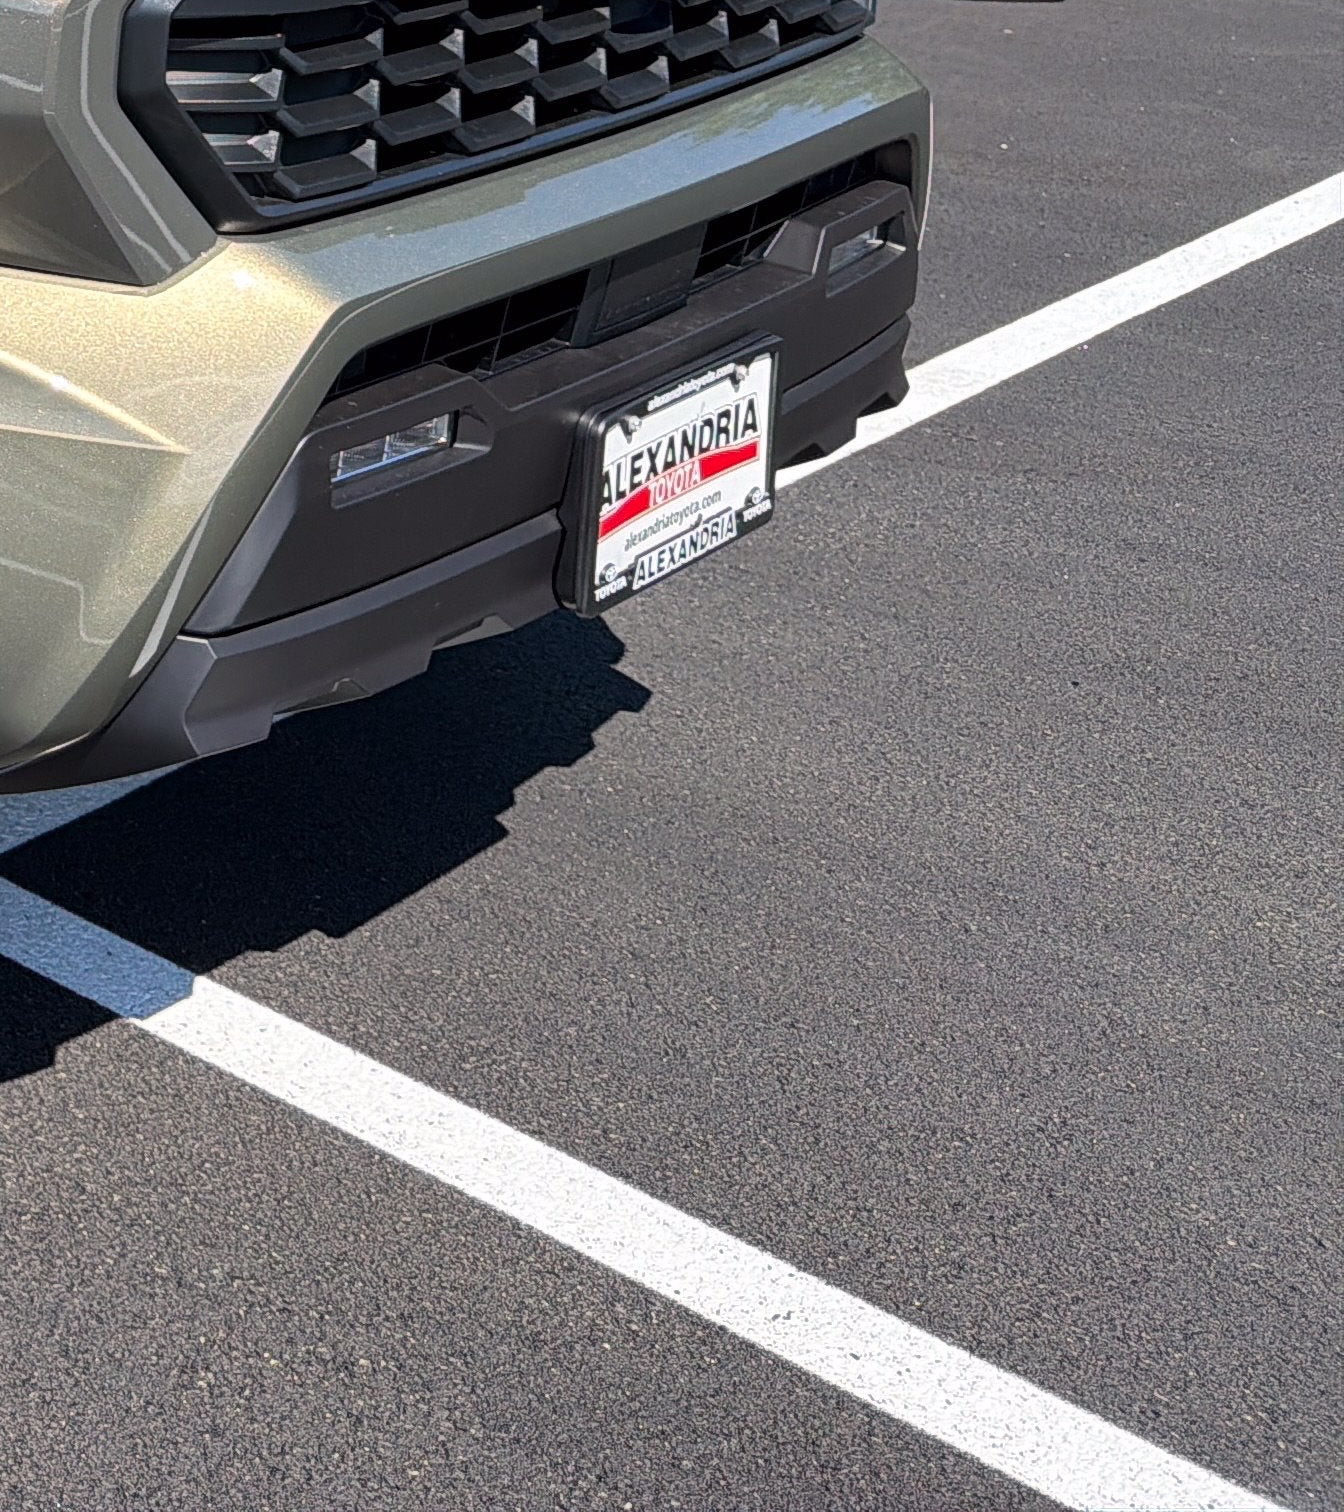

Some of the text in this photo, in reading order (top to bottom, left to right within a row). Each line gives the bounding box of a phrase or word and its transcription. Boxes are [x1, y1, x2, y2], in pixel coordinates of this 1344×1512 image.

[602, 397, 759, 508] ALEXANDRIA
[649, 461, 702, 508] TOYOTA
[743, 499, 772, 522] TOYOTA
[624, 489, 722, 552] alexandriatoyota.com
[634, 512, 736, 588] ALEXANDRIA
[594, 576, 628, 602] TOYOTA
